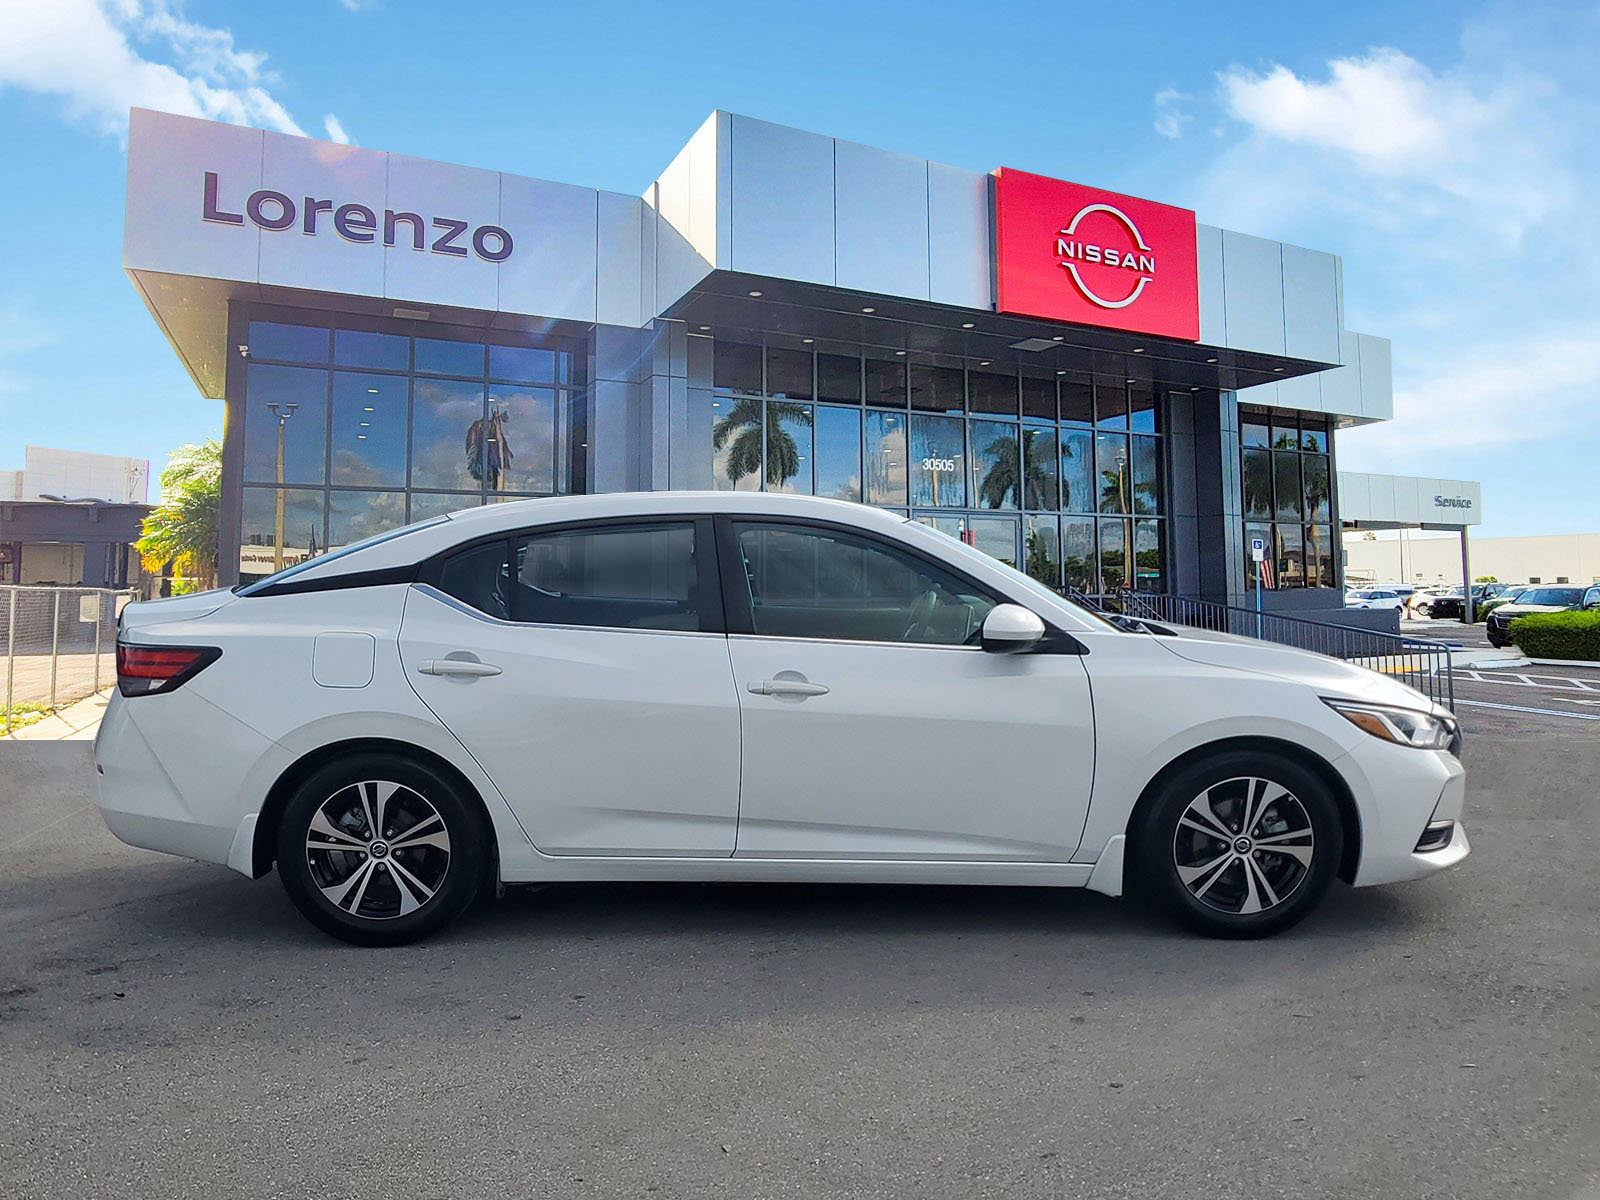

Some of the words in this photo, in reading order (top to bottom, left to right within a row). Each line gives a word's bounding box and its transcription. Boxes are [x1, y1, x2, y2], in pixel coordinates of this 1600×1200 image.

[203, 171, 514, 262] Lorenzo
[1057, 238, 1155, 273] NISSAN
[922, 457, 955, 472] 30505
[1434, 495, 1472, 508] Service
